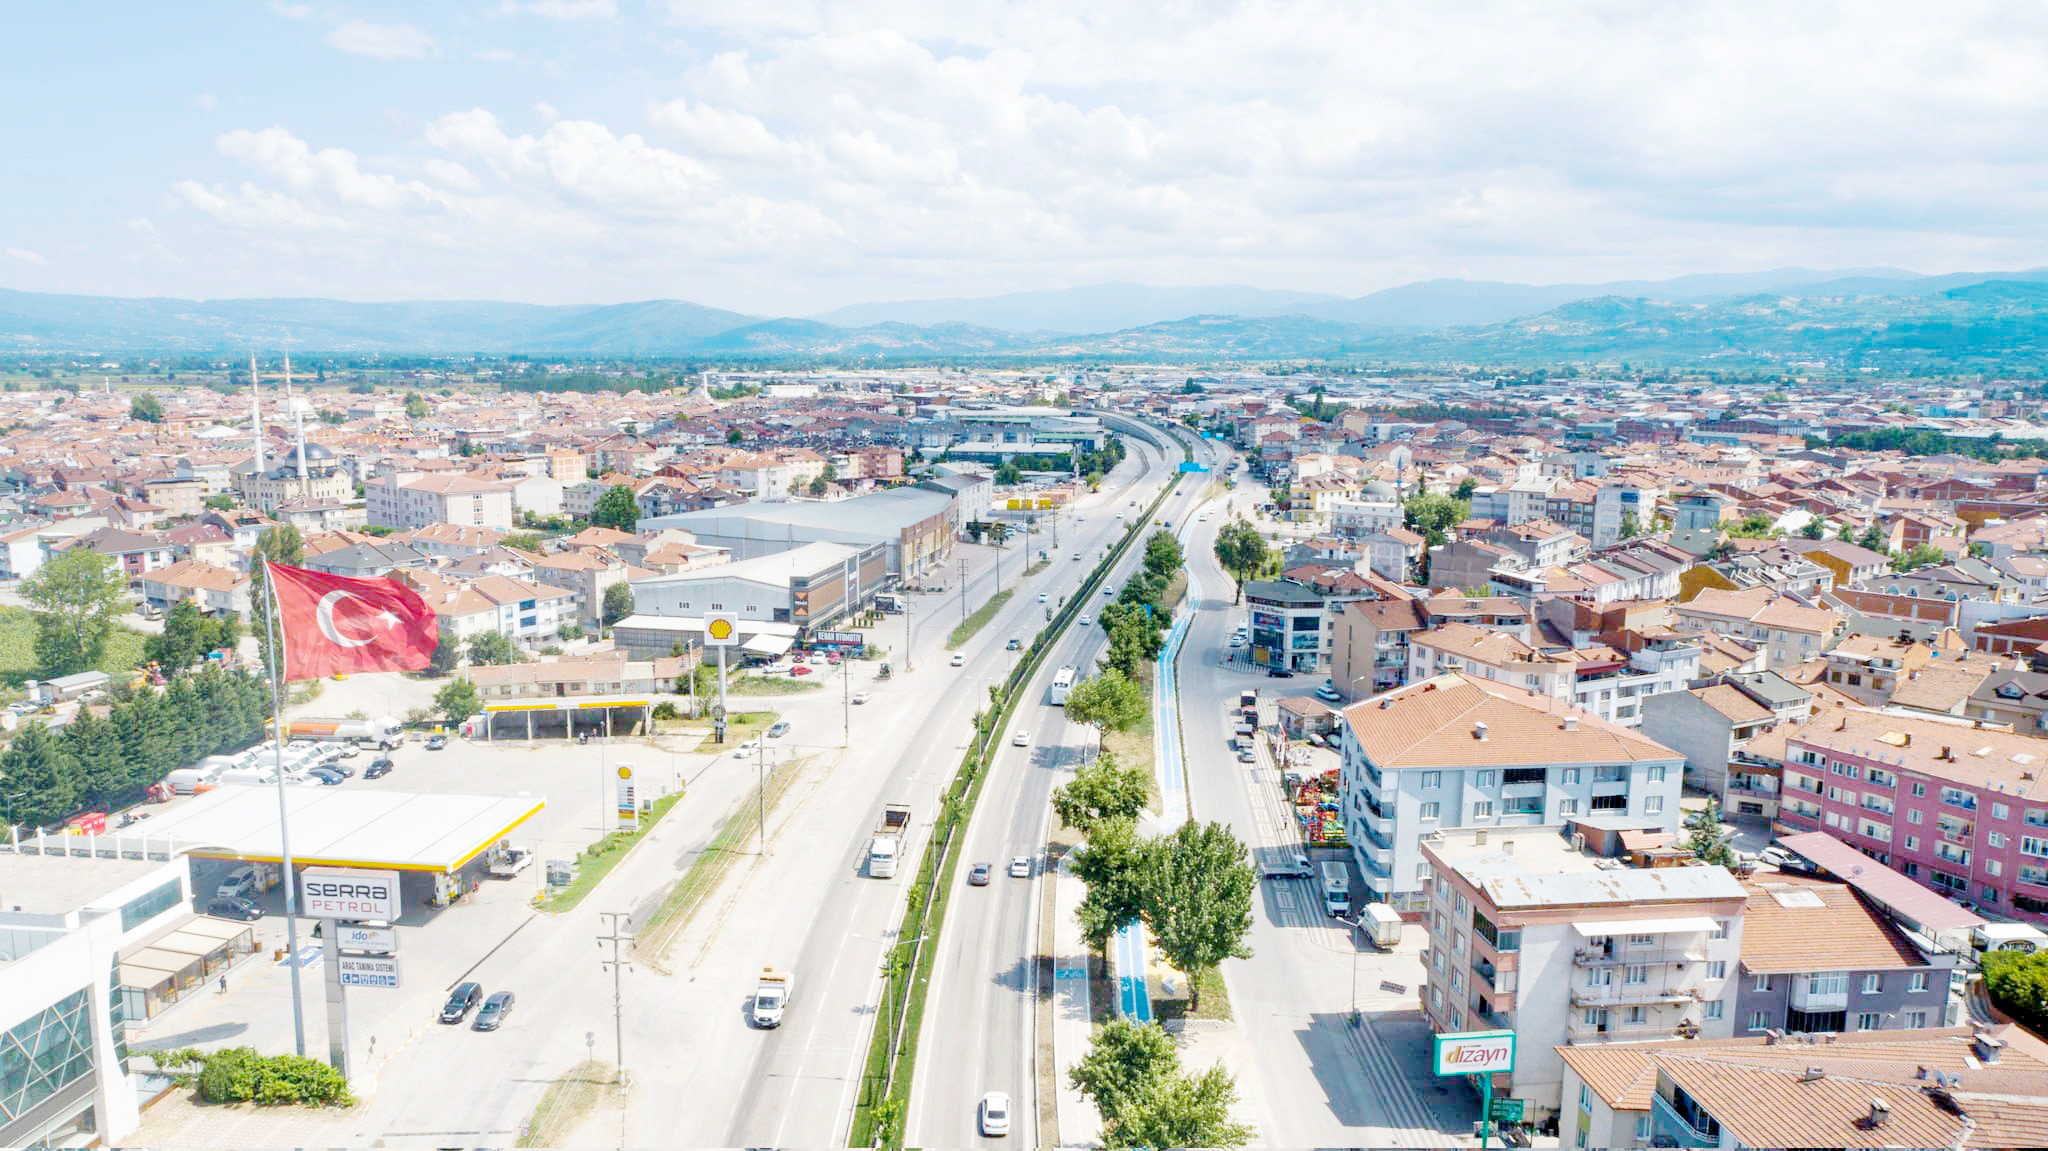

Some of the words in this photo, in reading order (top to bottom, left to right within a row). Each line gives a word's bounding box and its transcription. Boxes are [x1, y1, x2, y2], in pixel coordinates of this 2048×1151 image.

[306, 883, 387, 899] SERRA
[312, 900, 384, 913] PETROL
[352, 931, 368, 940] ido
[1446, 1045, 1507, 1066] dizayn
